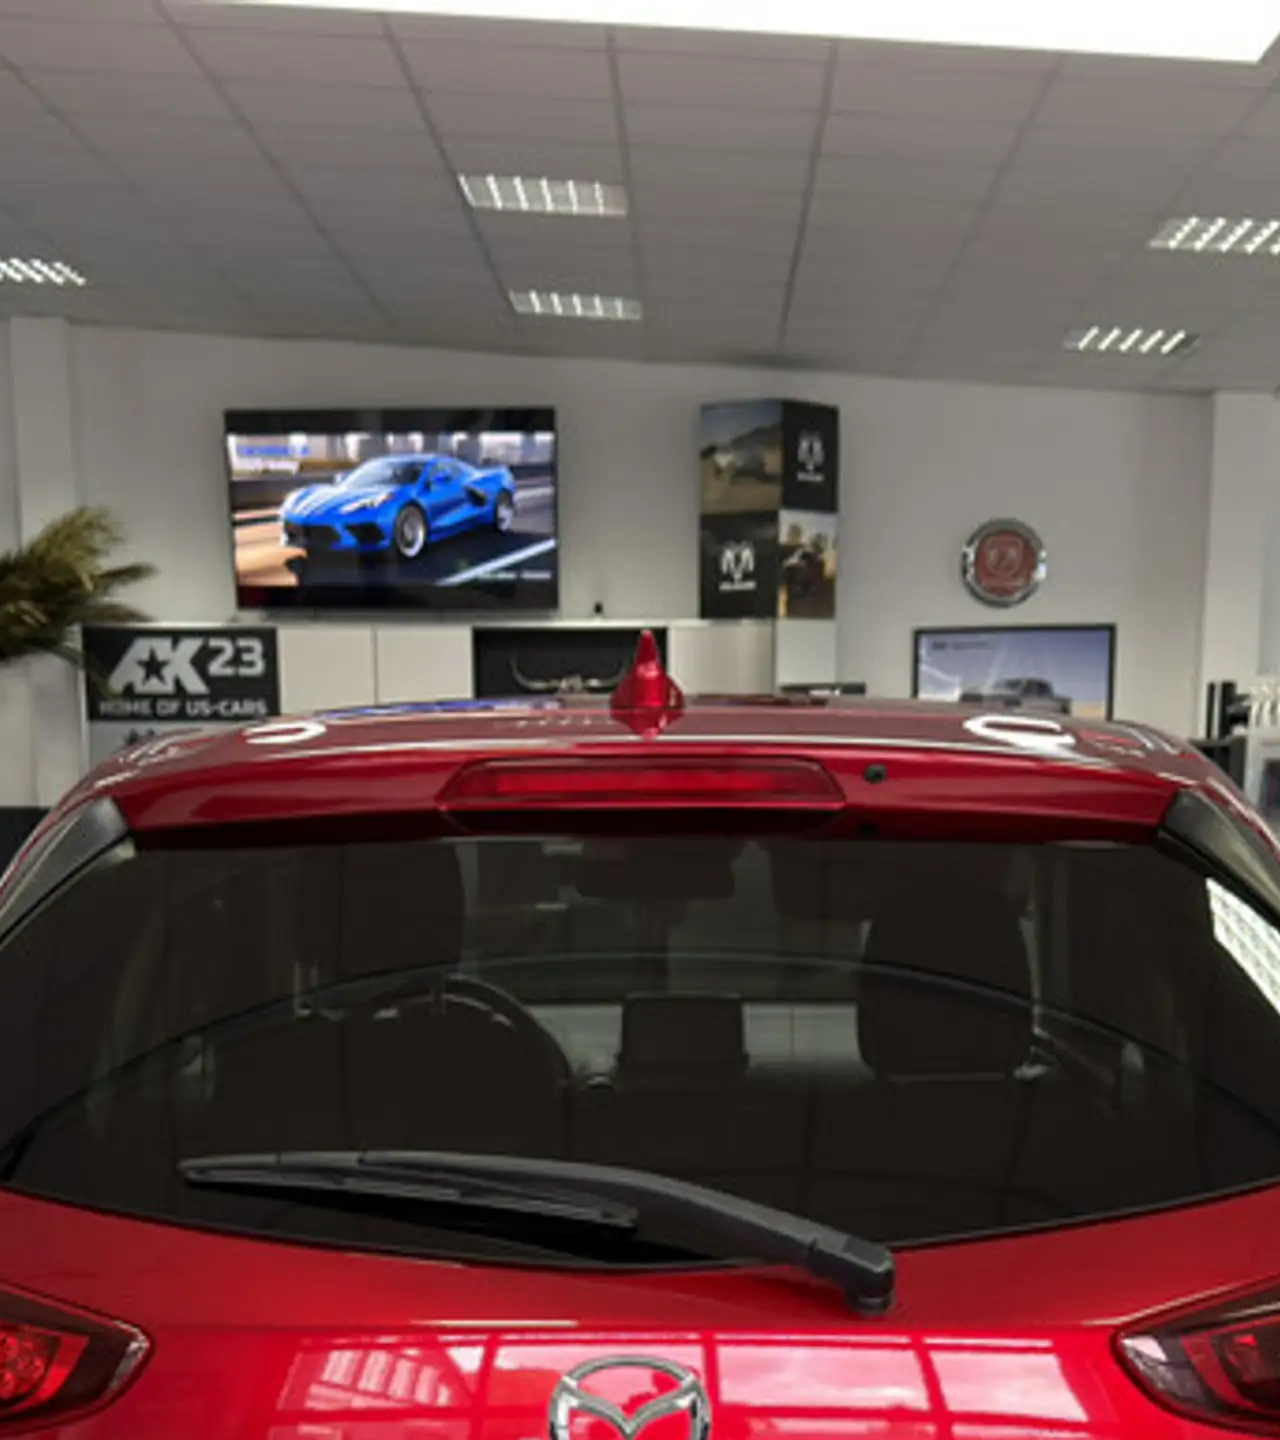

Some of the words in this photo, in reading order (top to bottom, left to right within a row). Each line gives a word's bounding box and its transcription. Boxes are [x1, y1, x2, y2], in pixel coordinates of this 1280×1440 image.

[100, 700, 152, 716] HOME
[156, 700, 180, 716] OF
[186, 699, 268, 715] US-CARS
